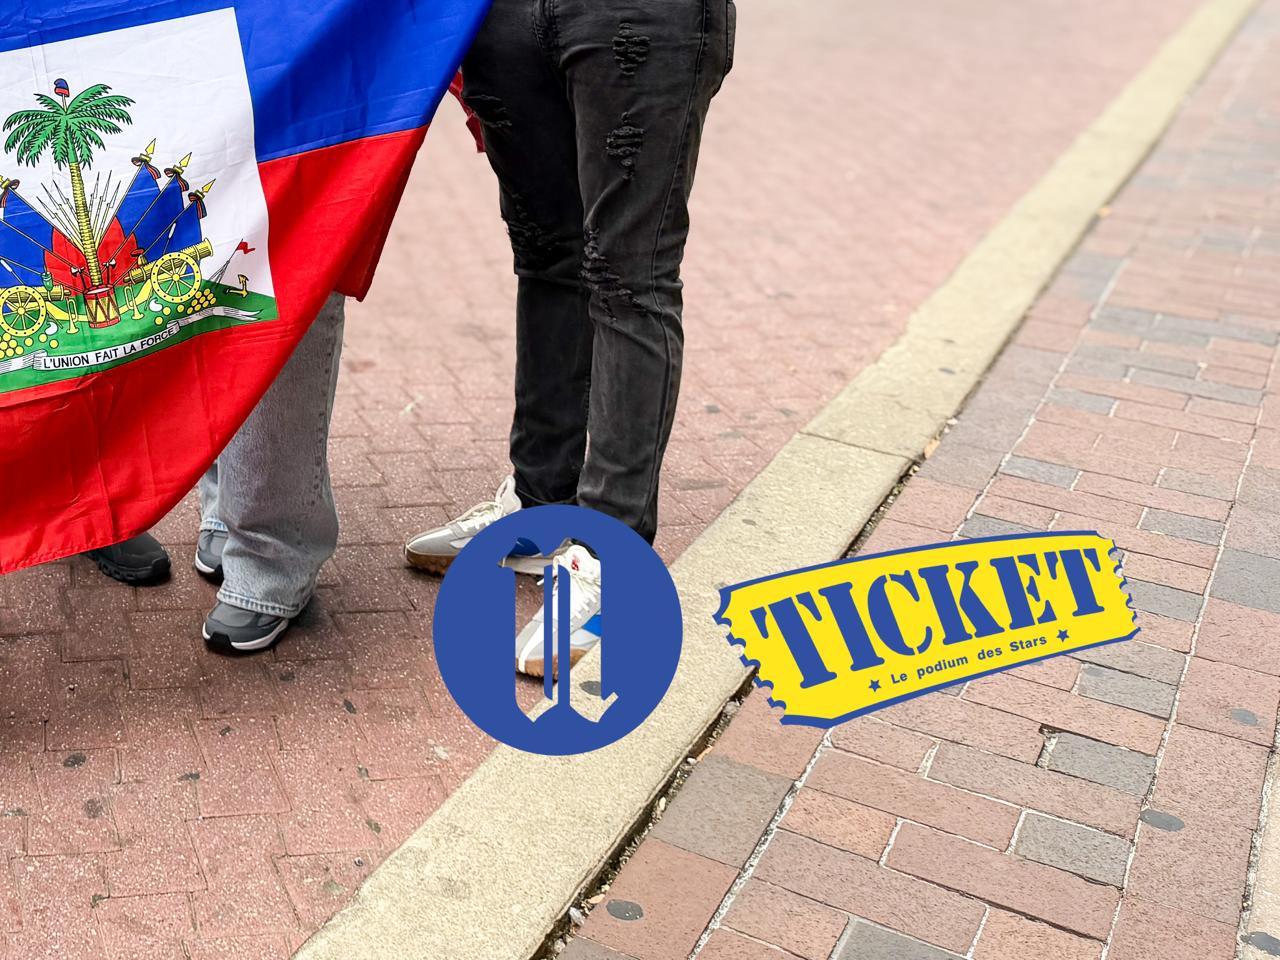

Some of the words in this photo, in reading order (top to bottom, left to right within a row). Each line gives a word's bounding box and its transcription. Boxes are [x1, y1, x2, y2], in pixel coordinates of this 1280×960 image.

[43, 354, 89, 369] L'UNION
[95, 348, 119, 363] FAIT
[123, 344, 137, 356] LA
[140, 326, 175, 350] FORCE
